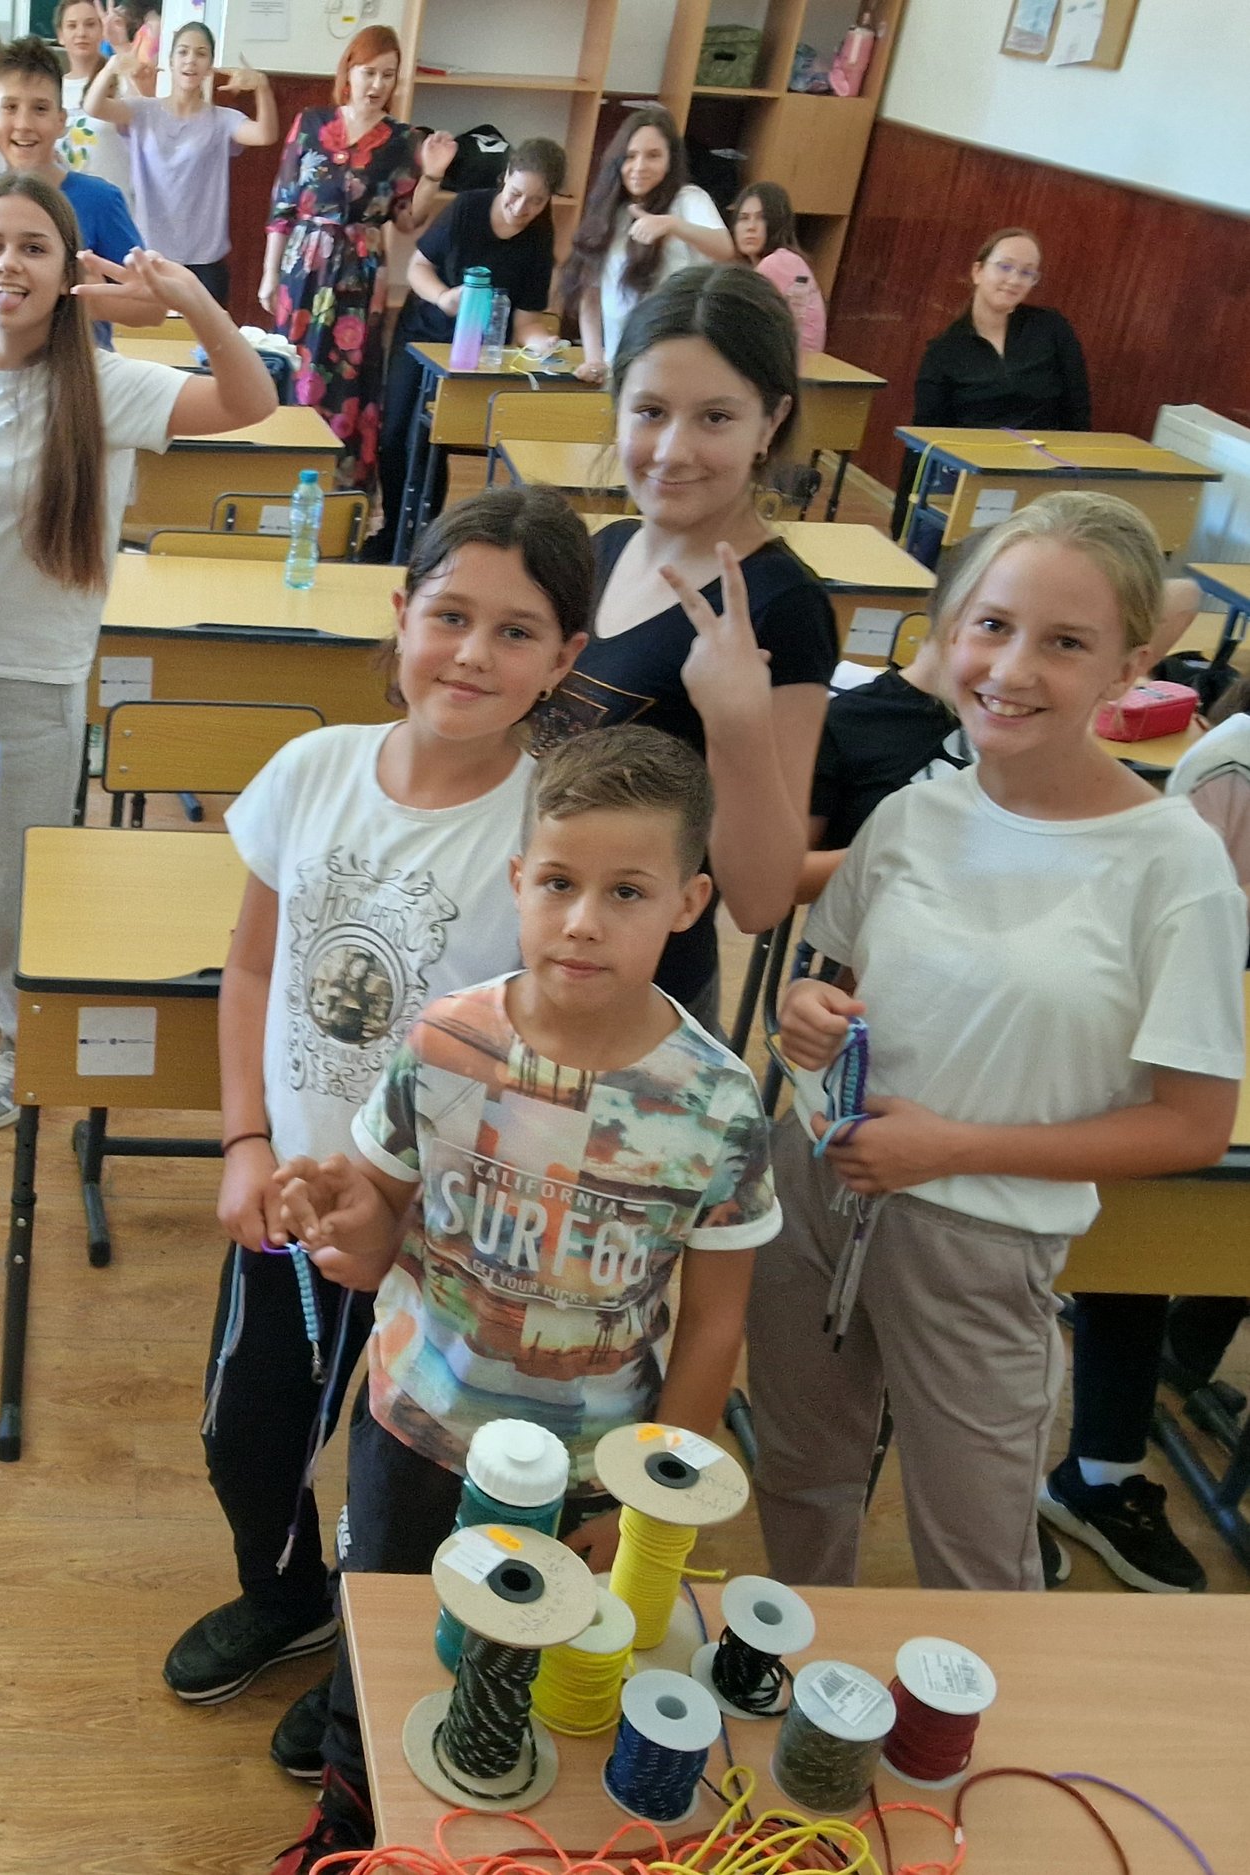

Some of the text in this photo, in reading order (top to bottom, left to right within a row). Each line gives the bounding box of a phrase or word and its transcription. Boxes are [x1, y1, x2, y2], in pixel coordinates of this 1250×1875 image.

[474, 1160, 618, 1216] CALIFORNIA
[473, 1259, 590, 1305] GET YOUR KICKS
